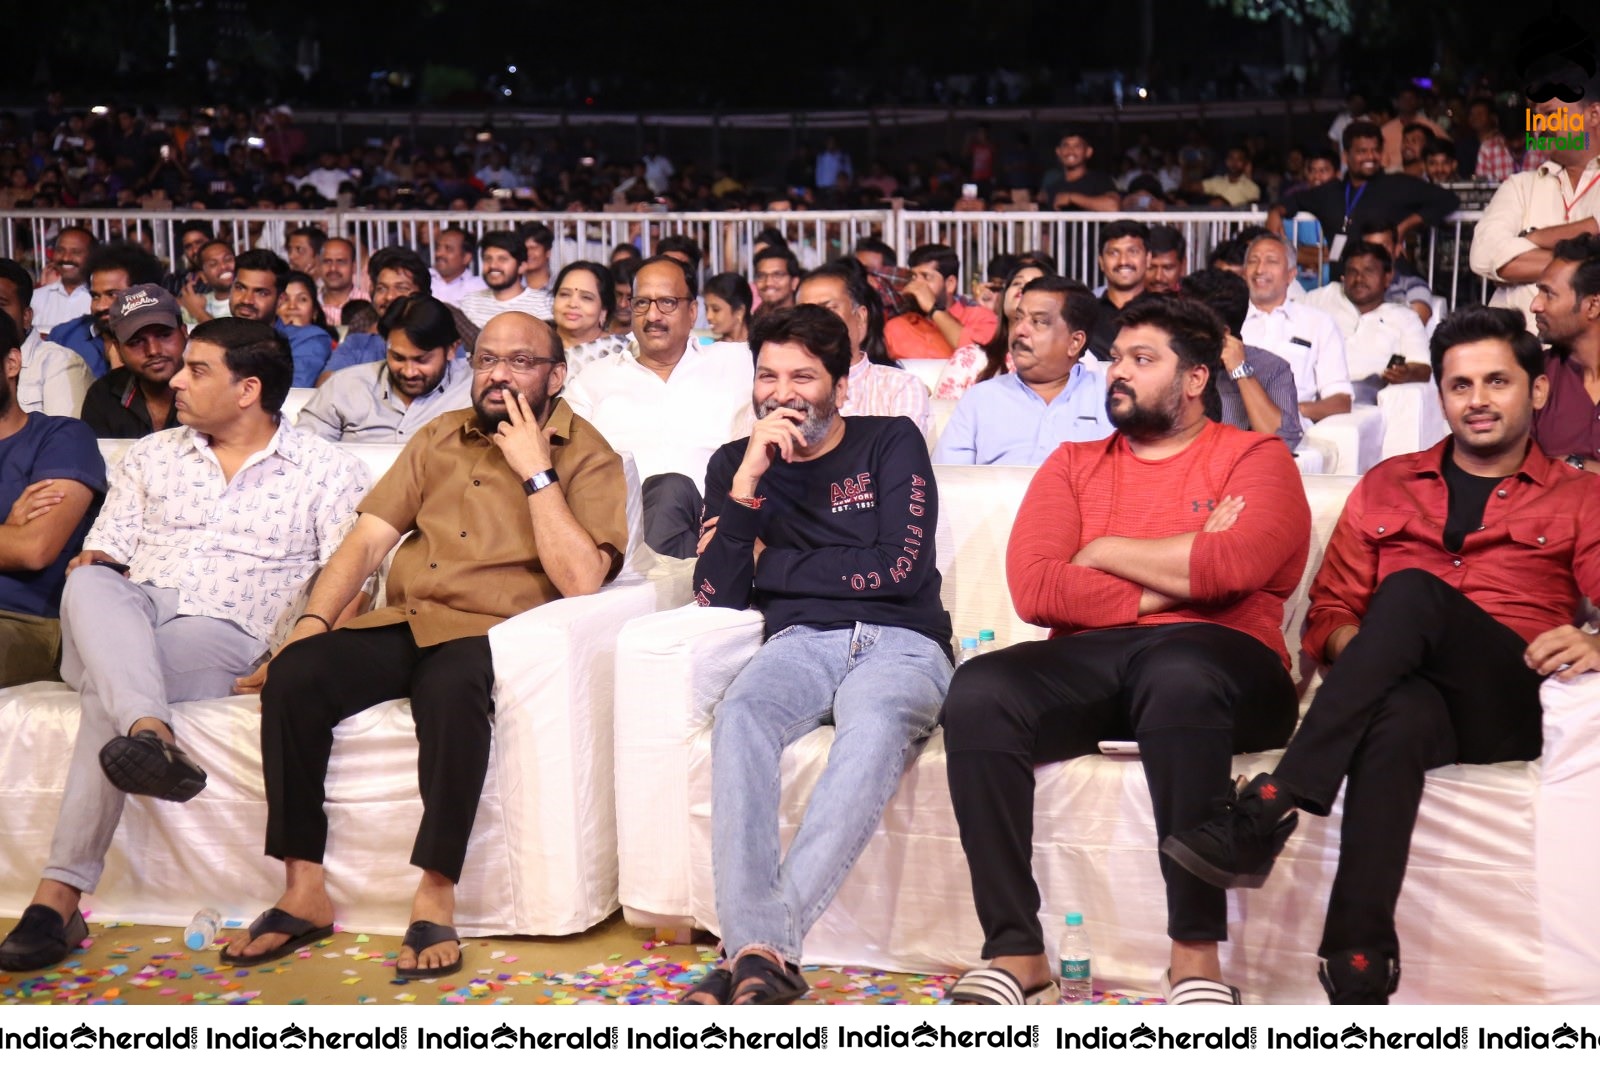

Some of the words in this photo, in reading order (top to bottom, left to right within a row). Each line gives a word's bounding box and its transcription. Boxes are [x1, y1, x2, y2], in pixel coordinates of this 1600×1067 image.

[831, 472, 871, 502] A&F
[909, 474, 926, 517] AND
[889, 524, 923, 583] FITCH
